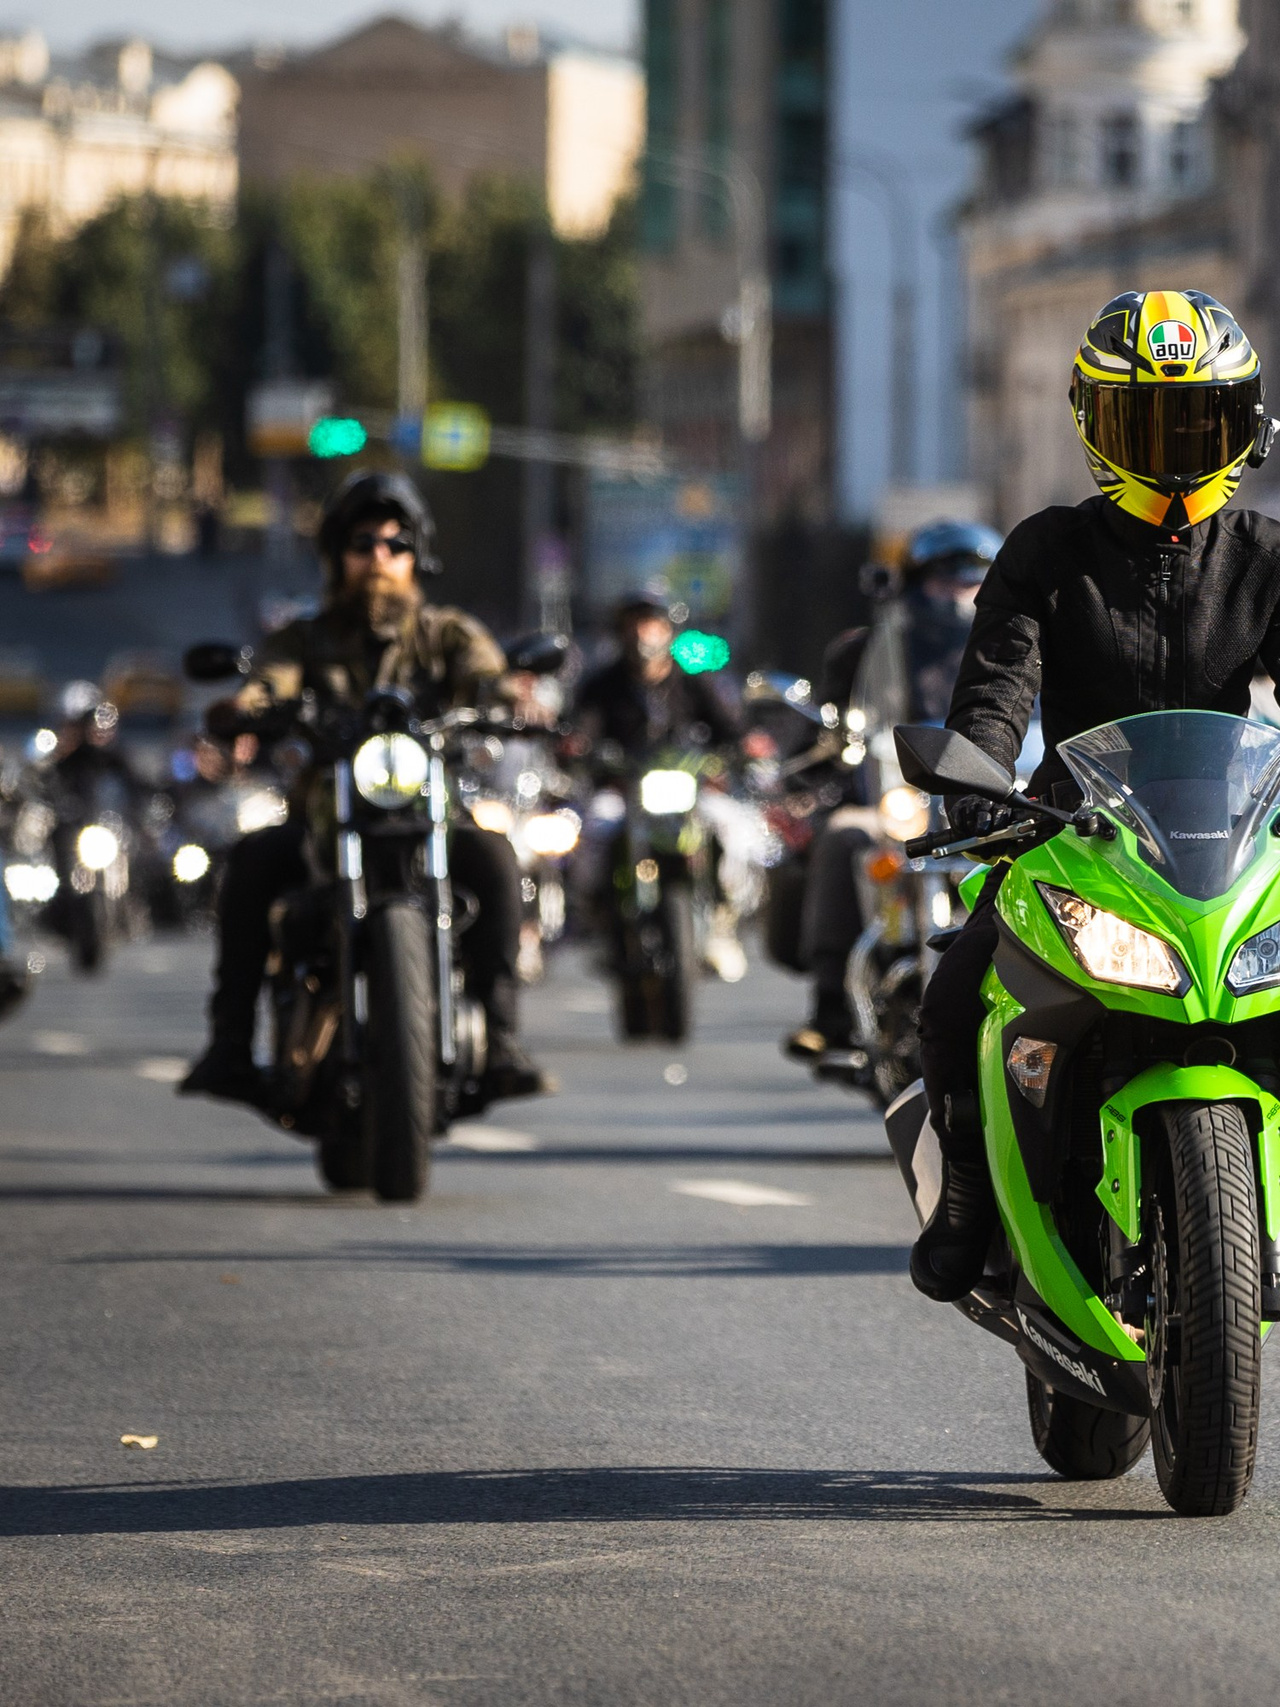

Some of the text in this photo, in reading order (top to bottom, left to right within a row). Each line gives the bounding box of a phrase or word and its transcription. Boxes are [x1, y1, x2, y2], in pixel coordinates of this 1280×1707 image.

[1156, 343, 1191, 360] agv
[1169, 830, 1229, 840] Kawasaki
[1104, 1104, 1127, 1123] ABS
[1266, 1103, 1280, 1120] ABS
[1016, 1306, 1108, 1397] Kawasaki
